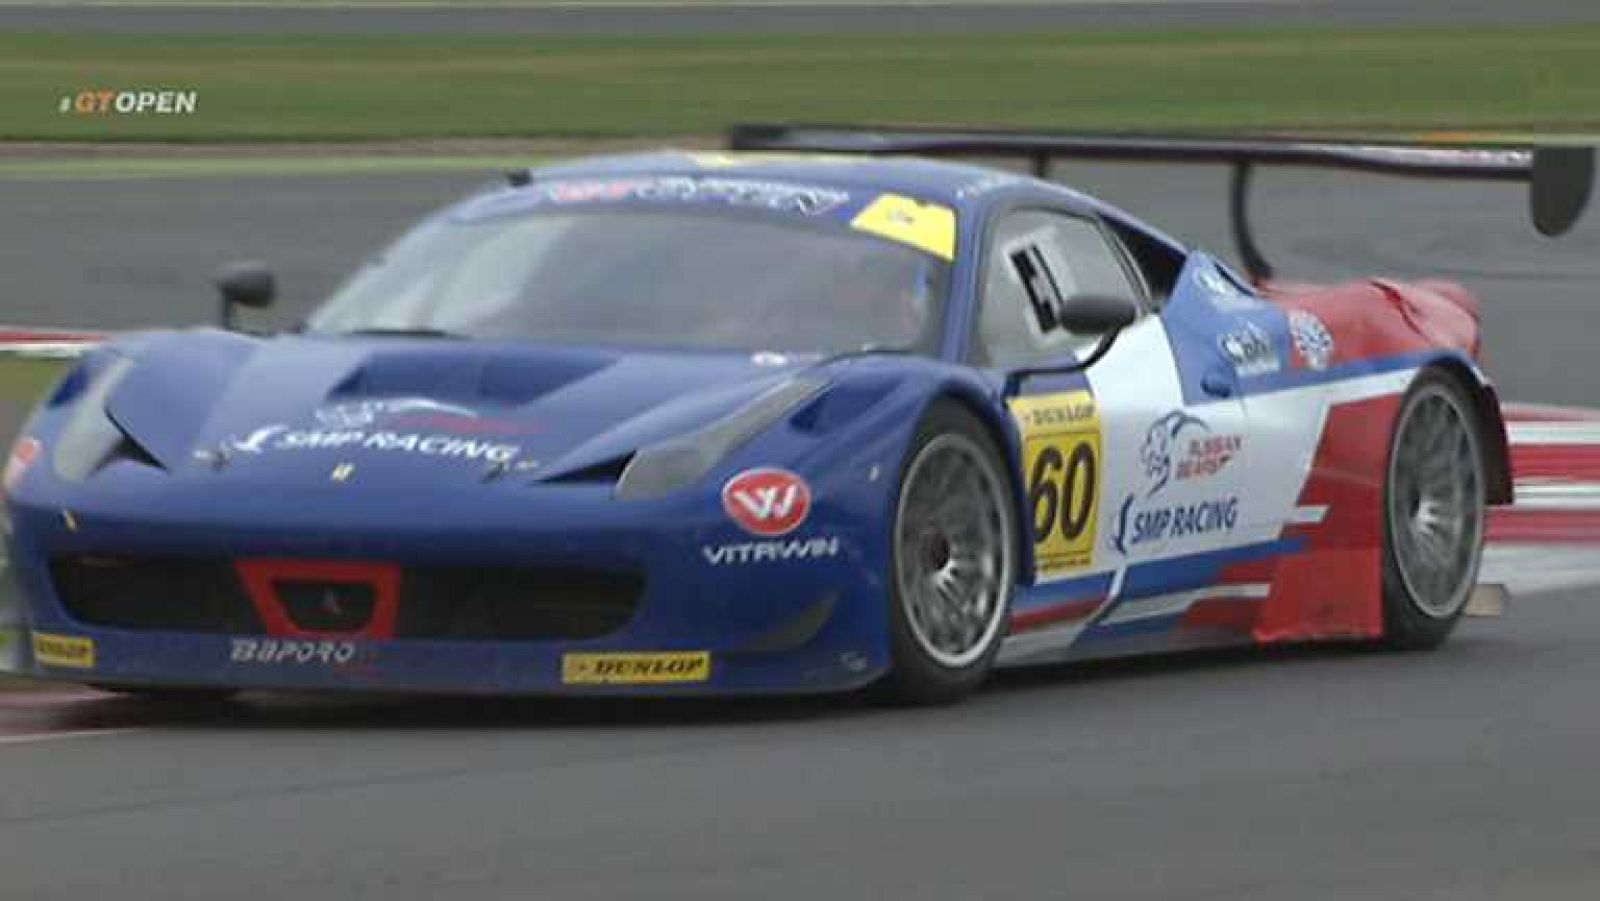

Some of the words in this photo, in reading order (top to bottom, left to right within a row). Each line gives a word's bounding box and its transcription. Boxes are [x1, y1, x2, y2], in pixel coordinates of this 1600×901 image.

[1031, 441, 1095, 543] 60
[1131, 507, 1171, 544] SMP
[1168, 496, 1239, 537] RACING
[594, 658, 704, 677] DUNLOP
